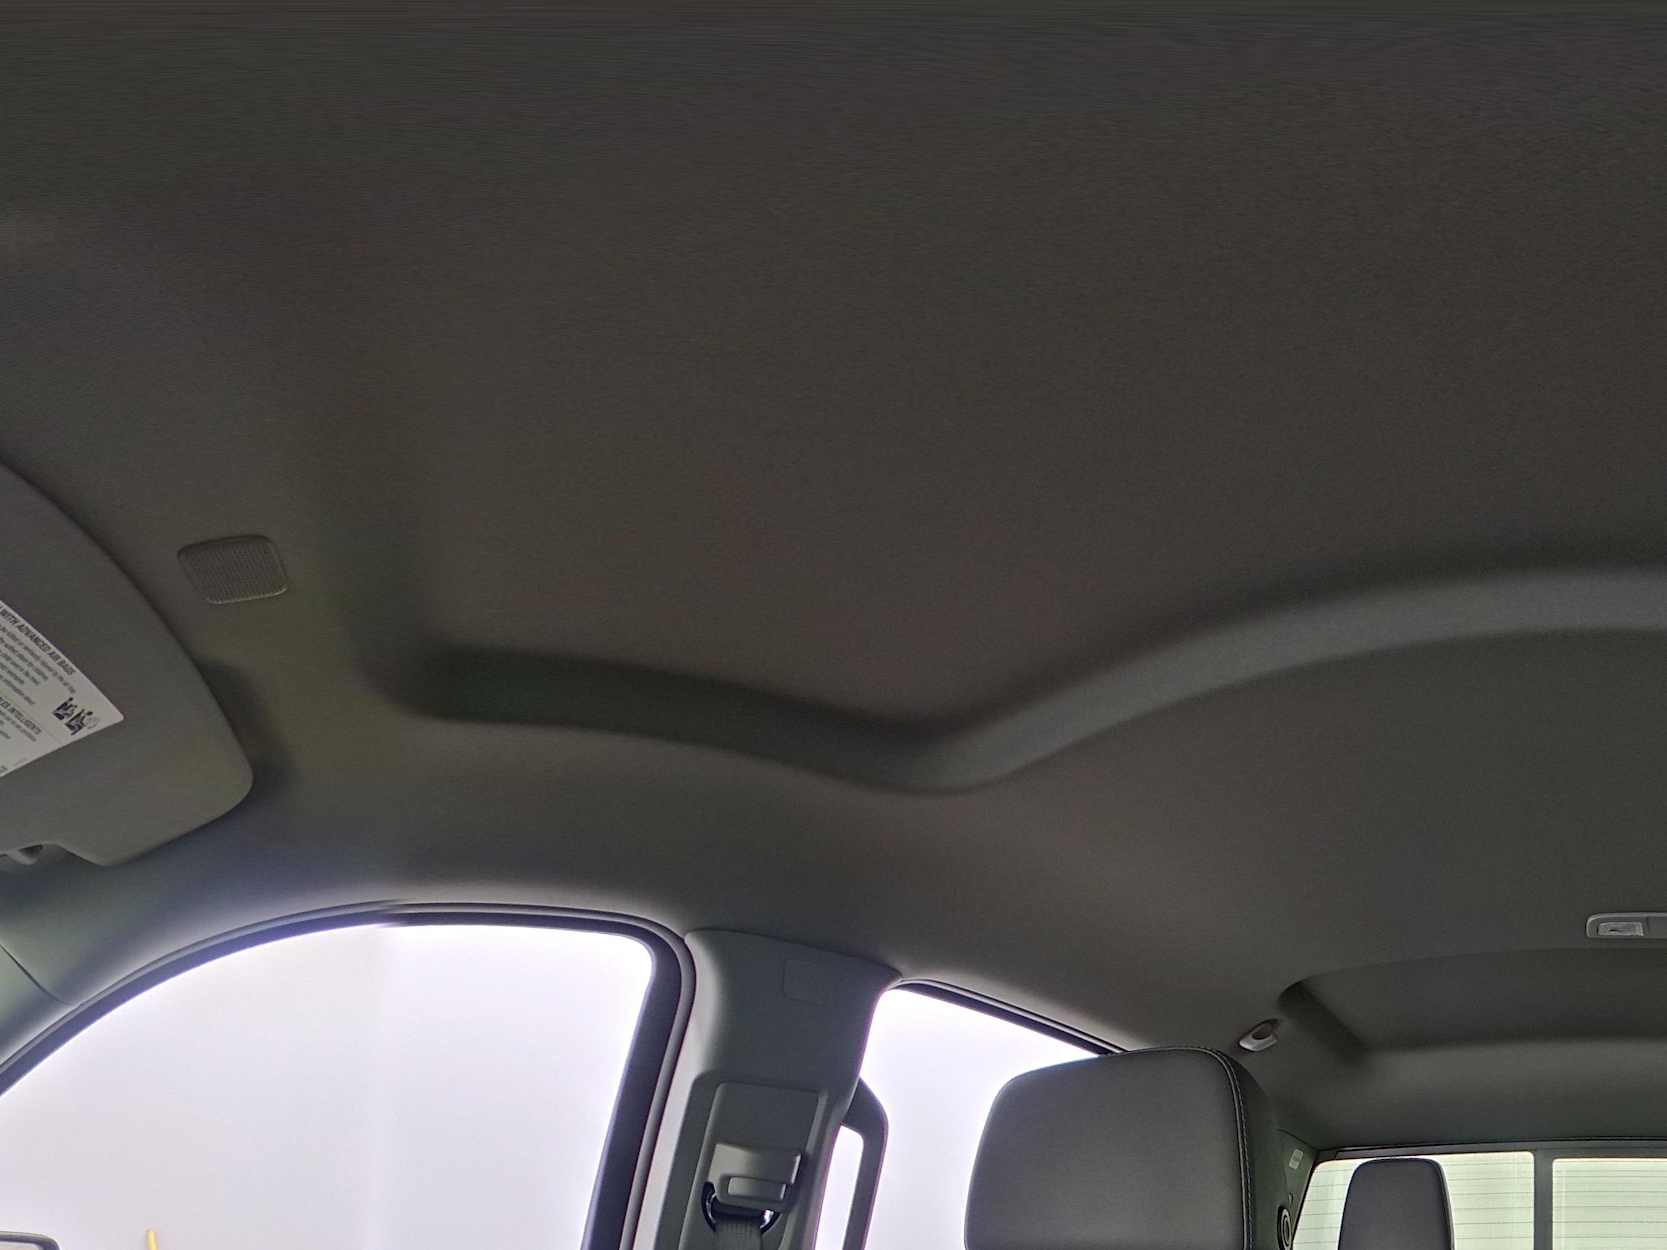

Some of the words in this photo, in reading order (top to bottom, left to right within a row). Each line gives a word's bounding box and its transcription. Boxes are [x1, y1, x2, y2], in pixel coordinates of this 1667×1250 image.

[14, 622, 51, 652] ADVANCED
[46, 650, 61, 661] AIR
[56, 659, 76, 675] BAGS
